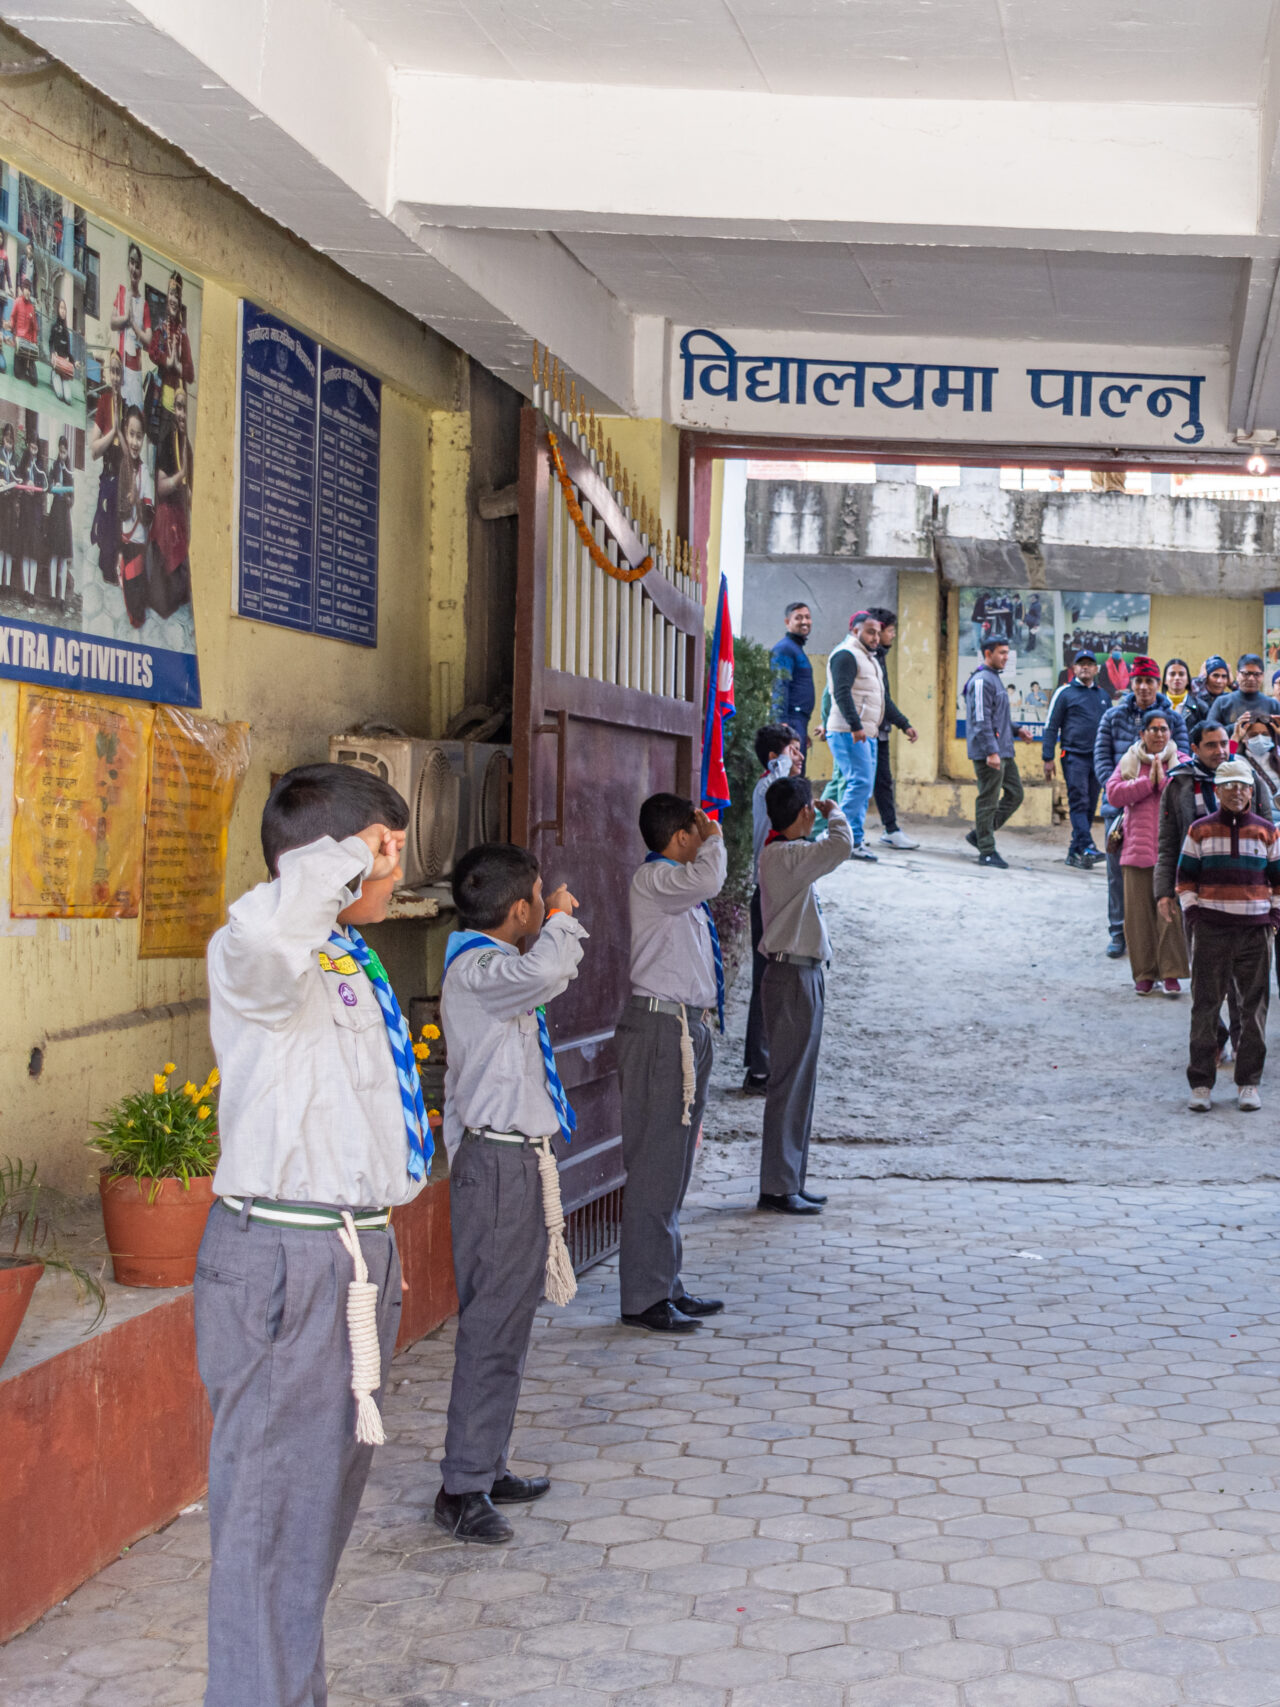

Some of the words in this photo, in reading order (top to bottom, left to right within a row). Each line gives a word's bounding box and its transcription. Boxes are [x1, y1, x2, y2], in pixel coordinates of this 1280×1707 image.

[680, 329, 998, 413] विद्यालयमा
[1027, 369, 1206, 444] पाल्नु
[53, 637, 154, 688] ACTIVITIES
